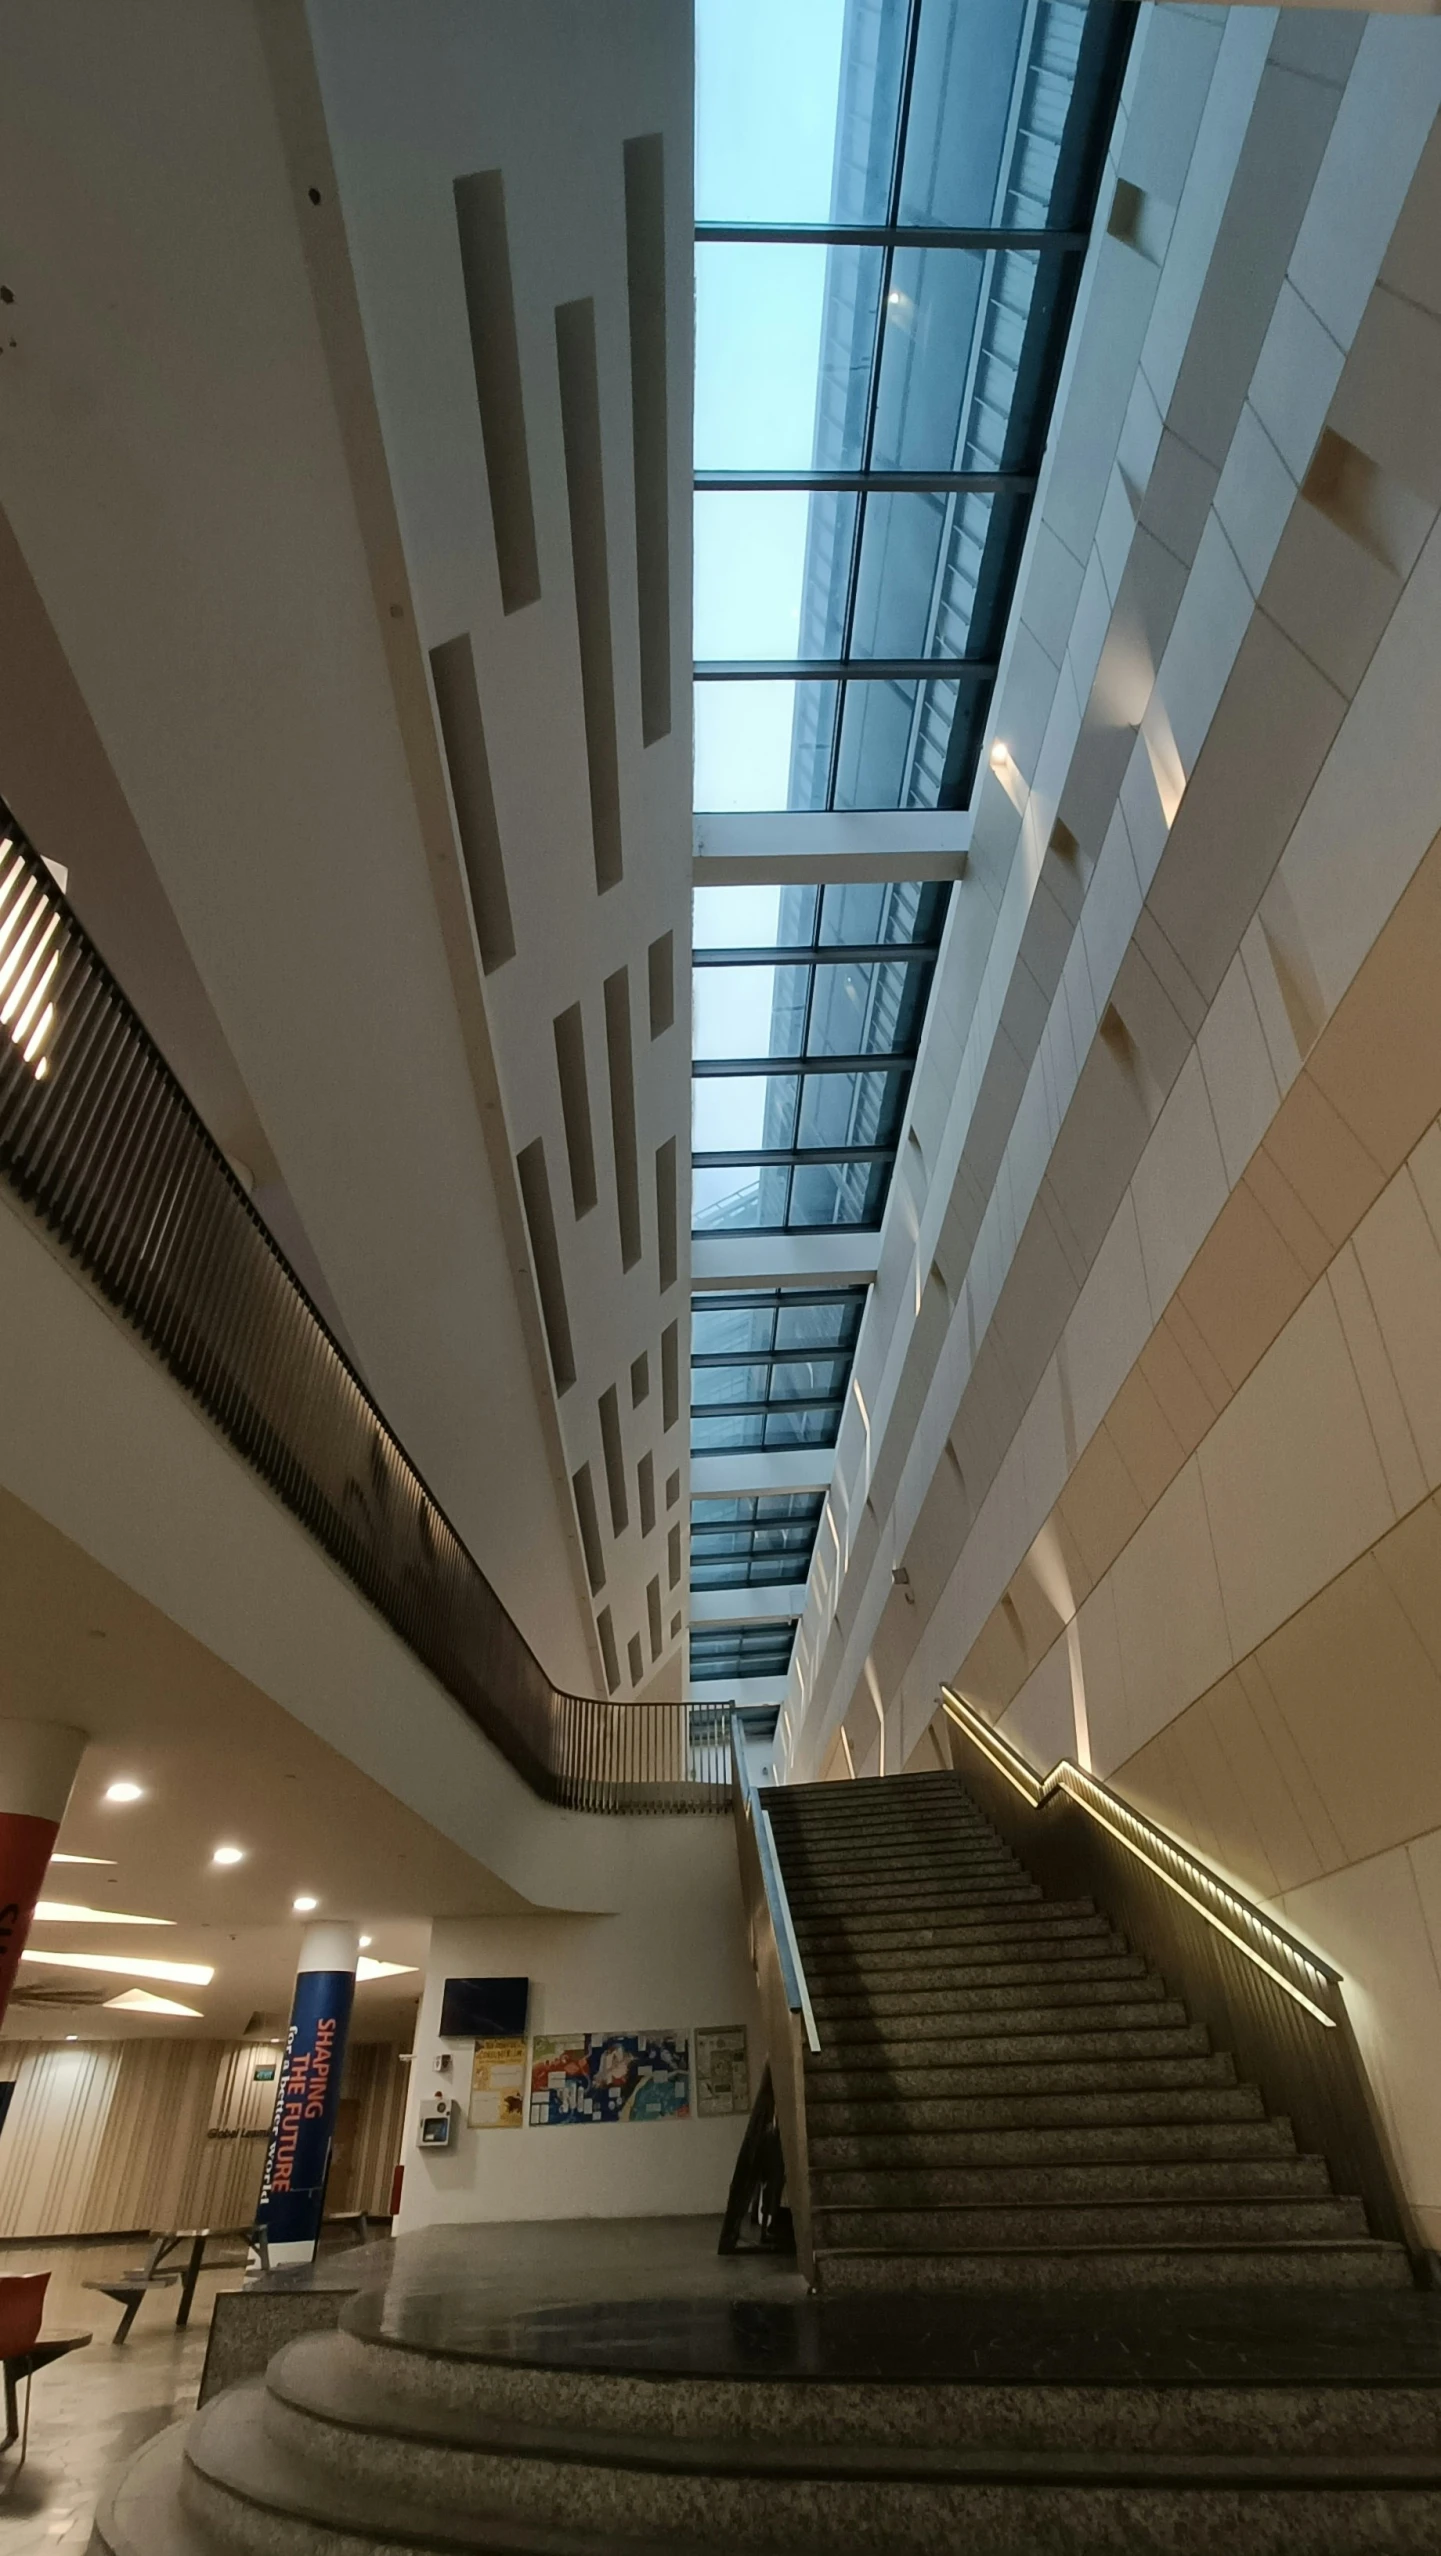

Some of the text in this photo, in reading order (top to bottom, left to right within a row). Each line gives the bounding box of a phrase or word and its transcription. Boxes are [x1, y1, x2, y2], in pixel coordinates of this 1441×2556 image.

[259, 2025, 298, 2205] for a better world
[270, 2053, 311, 2192] THE FUTURE
[305, 2018, 336, 2119] SHAPING
